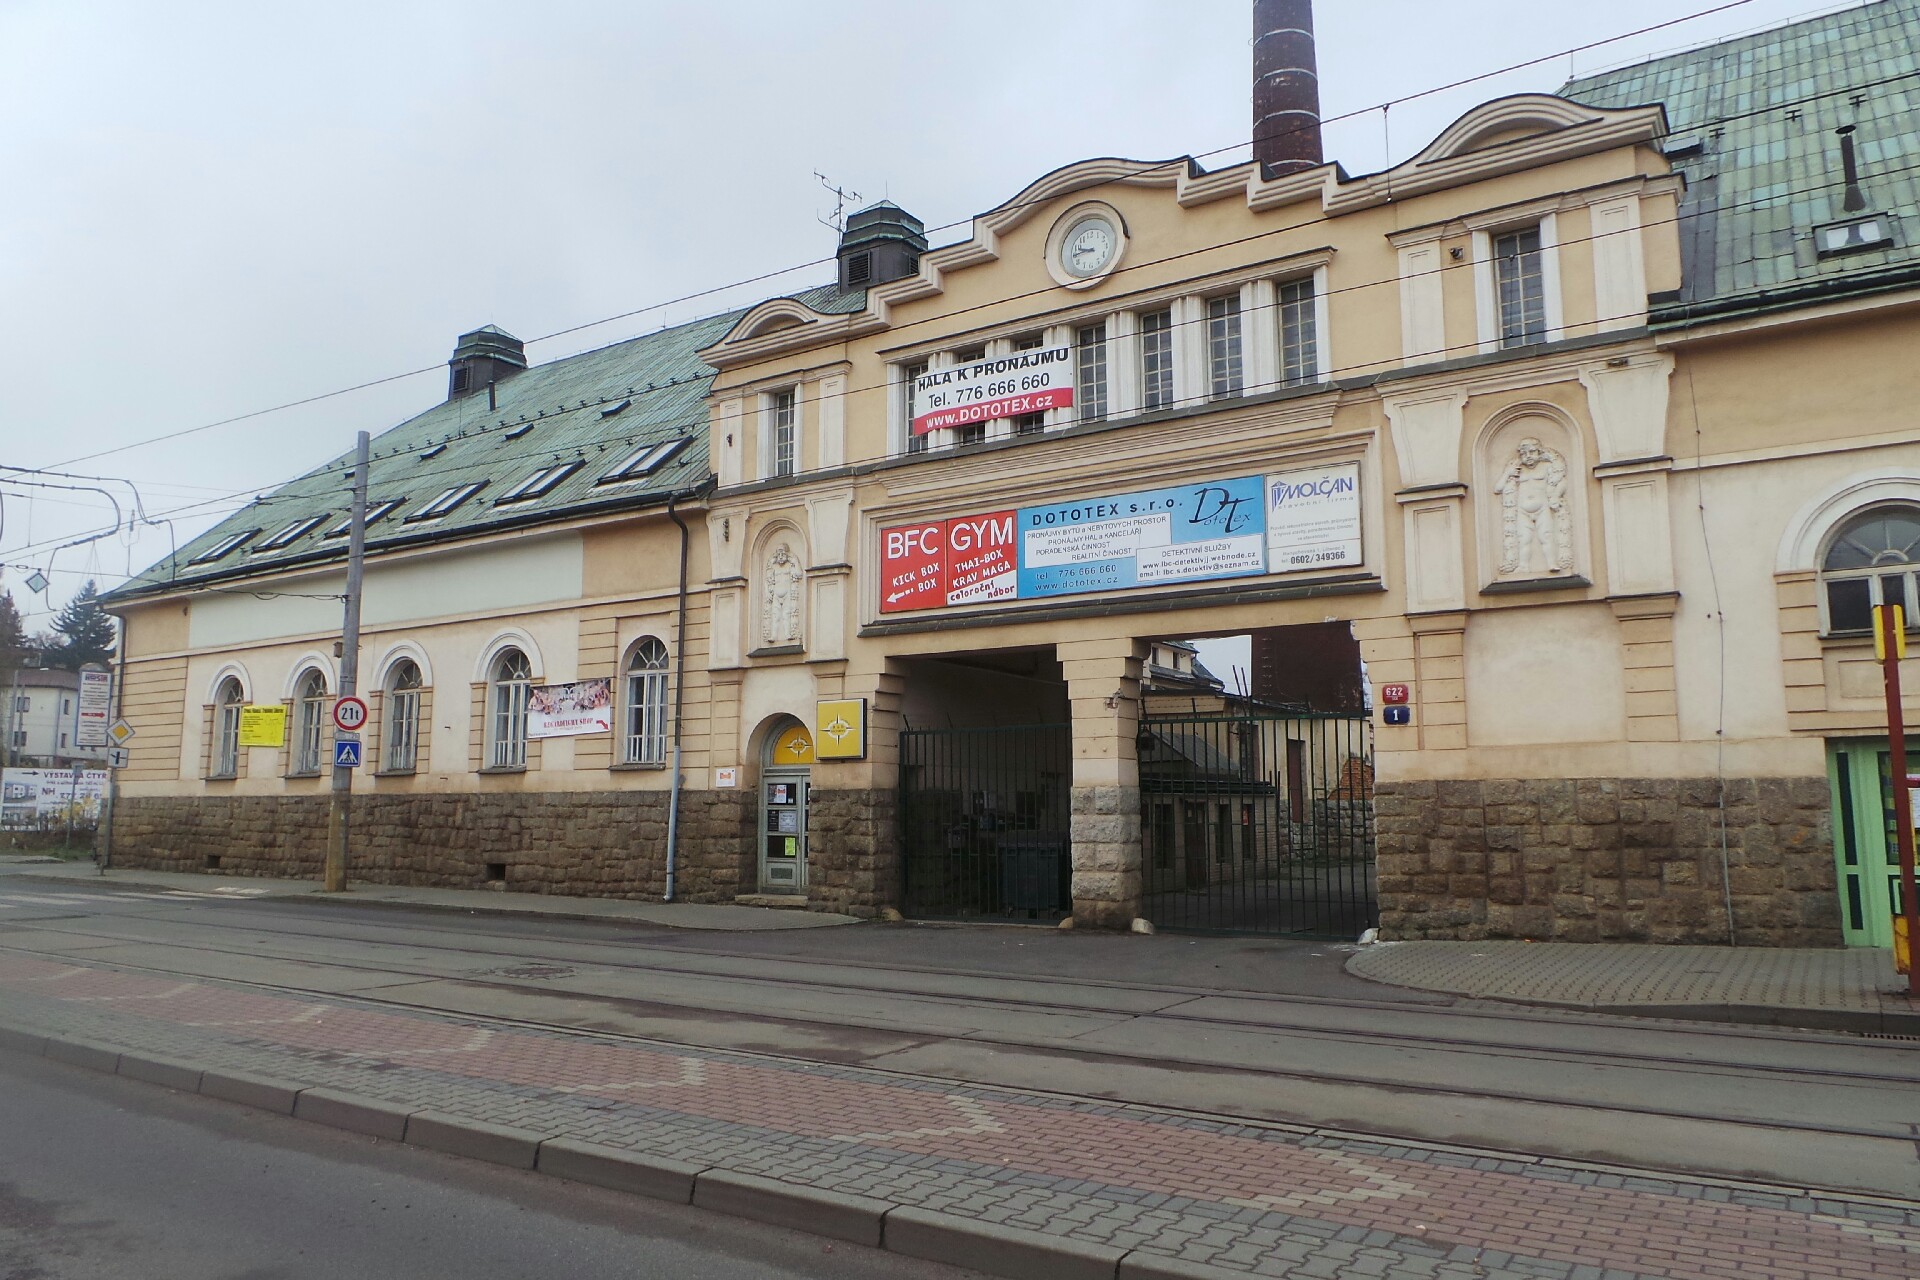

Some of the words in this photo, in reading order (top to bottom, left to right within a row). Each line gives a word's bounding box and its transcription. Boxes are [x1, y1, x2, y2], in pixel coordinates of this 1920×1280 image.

[918, 371, 952, 392] HALA
[957, 367, 970, 381] K
[973, 347, 1069, 378] PRONÁJMU
[928, 391, 951, 409] Tel.
[956, 387, 984, 403] 776
[988, 379, 1017, 397] 666
[1021, 372, 1051, 391] 660
[926, 395, 1053, 429] www.DOTOTEX.cz
[1279, 476, 1353, 505] MOLČAN
[1033, 503, 1119, 526] DOTOTEX
[1129, 499, 1183, 513] s.r.o.
[1133, 516, 1167, 527] PROSTOR
[887, 526, 939, 560] BFC
[950, 516, 1013, 552] GYM
[1084, 532, 1098, 541] HAL
[1036, 544, 1080, 556] PORADENSKÁ
[1082, 541, 1111, 551] ČINNOST
[1162, 546, 1203, 558] DETEKTIVNÍ
[1205, 543, 1232, 553] SLUŽBY
[955, 548, 1004, 573] THAI-BOX
[1290, 551, 1346, 565] 0602/349366
[892, 570, 916, 588] KICK
[921, 561, 940, 577] BOX
[952, 571, 978, 588] KRAV
[982, 560, 1011, 577] MAGA
[1058, 568, 1075, 577] 776
[1078, 566, 1096, 575] 666
[1099, 564, 1117, 574] 660
[918, 577, 937, 593] BOX
[950, 580, 995, 601] celoroční
[987, 584, 1015, 599] nábor
[1035, 577, 1118, 591] www.dototex.cz
[1386, 687, 1403, 696] 622
[1393, 709, 1399, 721] 1
